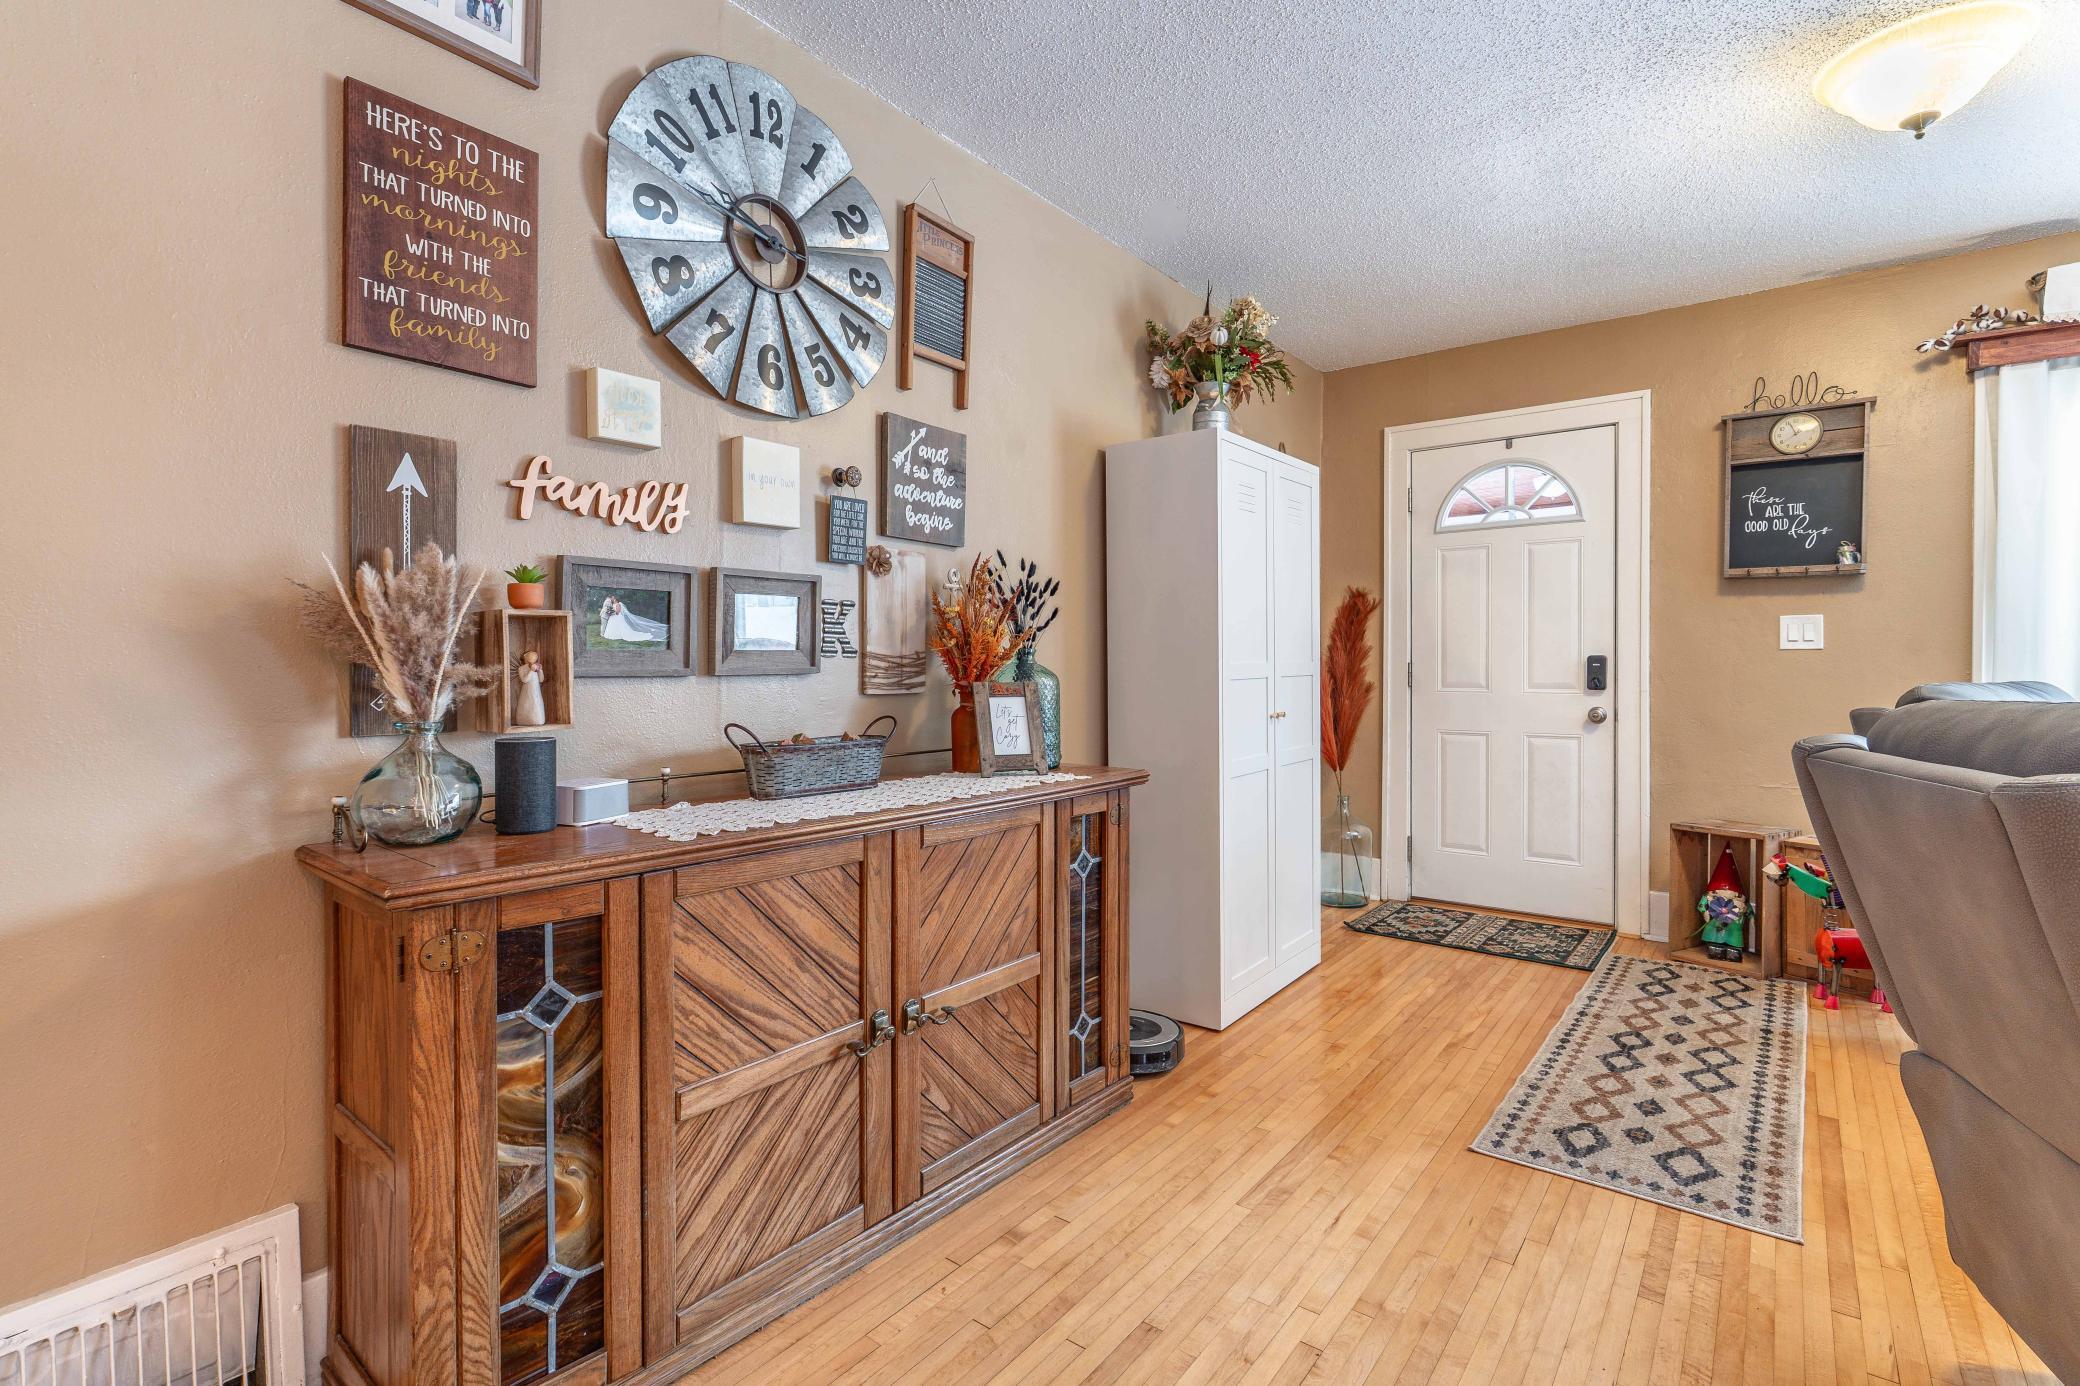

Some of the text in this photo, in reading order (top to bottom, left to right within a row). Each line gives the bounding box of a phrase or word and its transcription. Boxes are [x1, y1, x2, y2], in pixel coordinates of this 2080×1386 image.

[689, 83, 737, 141] 11
[749, 91, 784, 150] 12
[366, 101, 525, 184] HERE'S TO THE
[645, 109, 695, 174] 10
[800, 142, 827, 181] 1
[392, 146, 503, 196] nights
[358, 161, 531, 238] THAT TURNED INTO
[632, 182, 679, 225] 9
[831, 204, 870, 240] 2
[361, 193, 528, 260] mornings
[383, 249, 510, 303] friends
[405, 233, 493, 277] WITH THE
[652, 254, 695, 296] 8
[848, 267, 882, 300] 3
[358, 276, 530, 340] THAT TURNED INTO
[389, 307, 502, 362] family
[703, 308, 735, 355] 7
[838, 312, 871, 352] 4
[757, 343, 784, 391] 6
[804, 342, 836, 388] 5
[1743, 371, 1858, 411] hello
[912, 465, 955, 489] so the
[918, 445, 949, 466] and
[506, 455, 689, 534] family
[894, 483, 964, 510] adventure
[1765, 502, 1806, 518] ARE THE
[905, 504, 954, 534] begins
[1772, 518, 1789, 531] OLD
